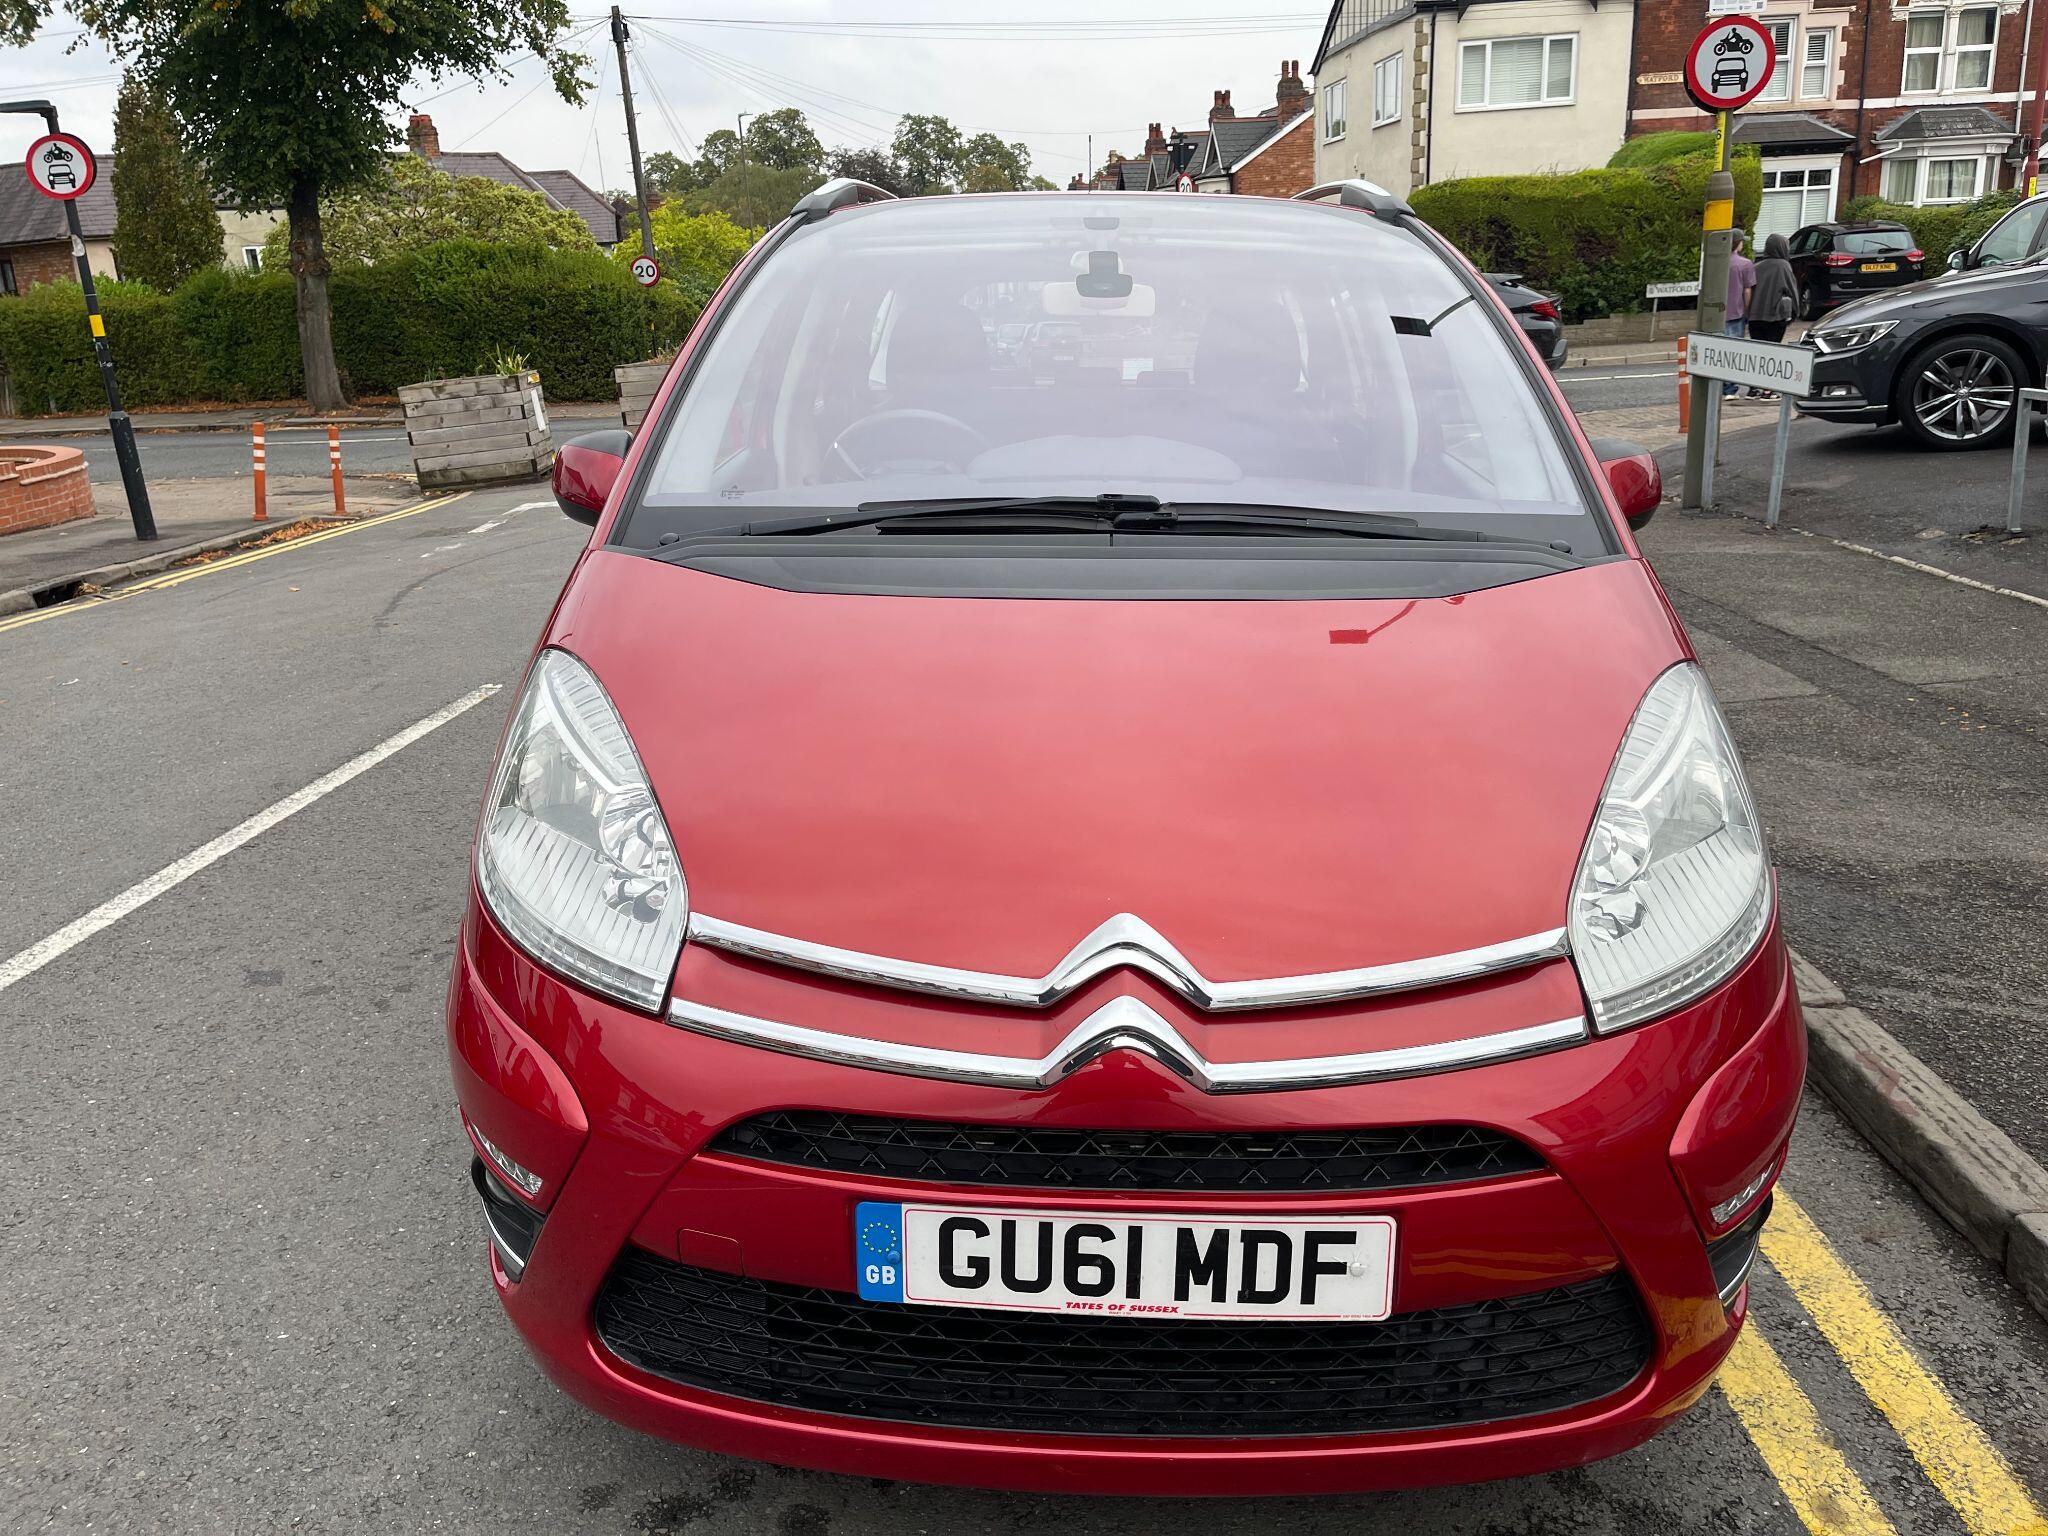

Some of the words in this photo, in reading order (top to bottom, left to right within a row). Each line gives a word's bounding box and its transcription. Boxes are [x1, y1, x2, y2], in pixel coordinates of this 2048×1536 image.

[1643, 74, 1680, 83] WATFORD
[634, 264, 656, 278] 20
[1655, 284, 1693, 294] WATFORD
[1703, 347, 1758, 374] FRANKLIN
[1758, 356, 1794, 380] ROAD
[938, 1216, 1143, 1300] GU61
[1174, 1227, 1357, 1305] MDF
[866, 1264, 896, 1285] GB
[1065, 1301, 1104, 1311] TATES
[1107, 1303, 1126, 1311] OF
[1129, 1304, 1179, 1314] SUSSEX
